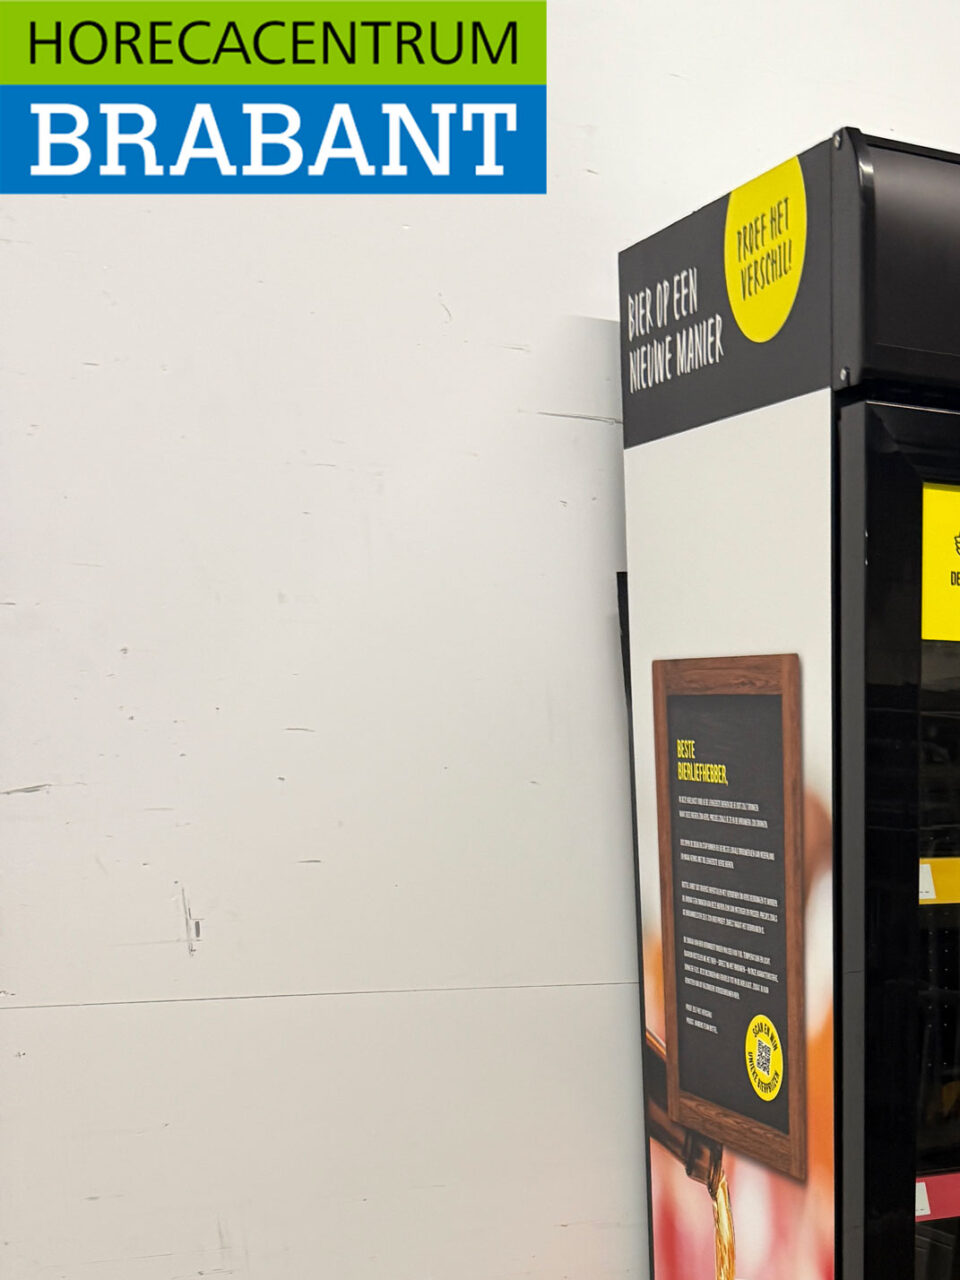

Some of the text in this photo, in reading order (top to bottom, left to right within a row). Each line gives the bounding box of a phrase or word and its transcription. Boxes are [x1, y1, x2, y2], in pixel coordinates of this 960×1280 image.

[737, 197, 789, 263] PROEF HET
[740, 239, 792, 301] VERSCHIL!
[627, 266, 697, 341] BIER OP EEN
[629, 313, 724, 394] NIEUWE MANIER
[677, 739, 695, 759] BESTE
